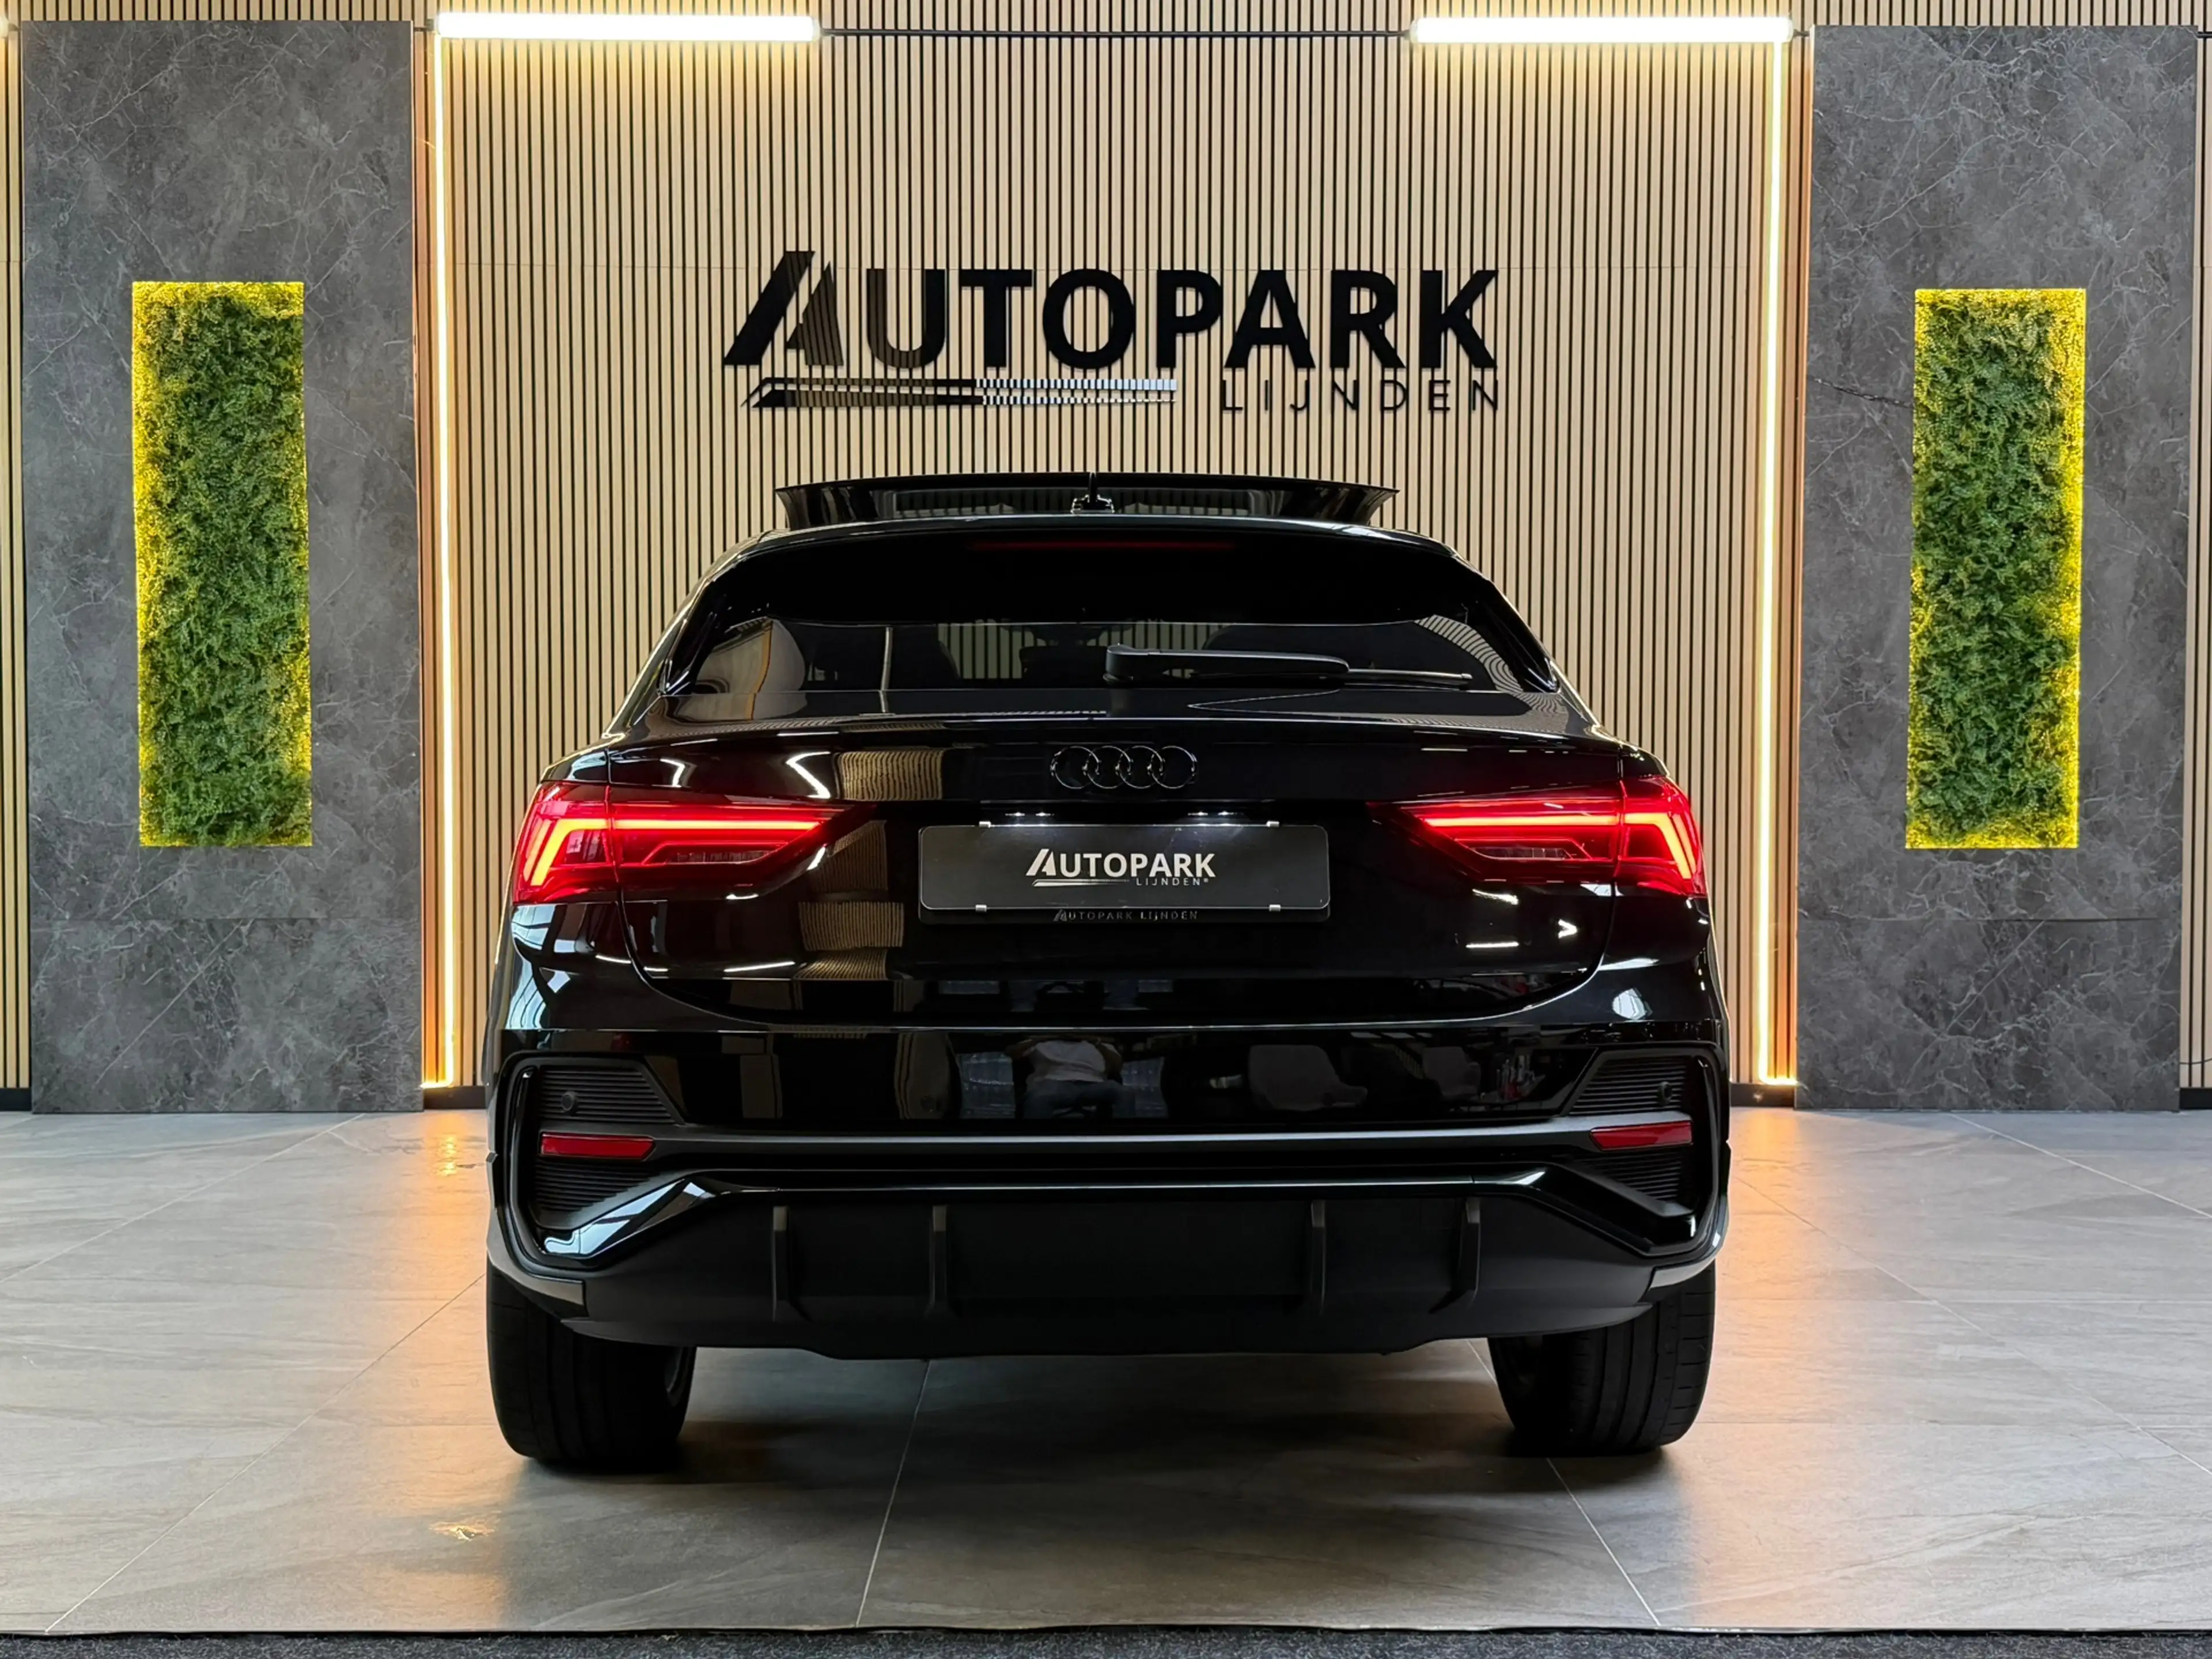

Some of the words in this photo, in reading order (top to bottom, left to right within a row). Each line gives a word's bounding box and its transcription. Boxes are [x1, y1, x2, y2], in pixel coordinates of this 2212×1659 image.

[723, 250, 1499, 370] AUTOPARK
[1222, 379, 1499, 411] LIJNDEN
[1025, 848, 1217, 878] AUTOPARK
[1053, 908, 1133, 922] AUTOPARK
[1140, 910, 1198, 921] LIJNDEN
